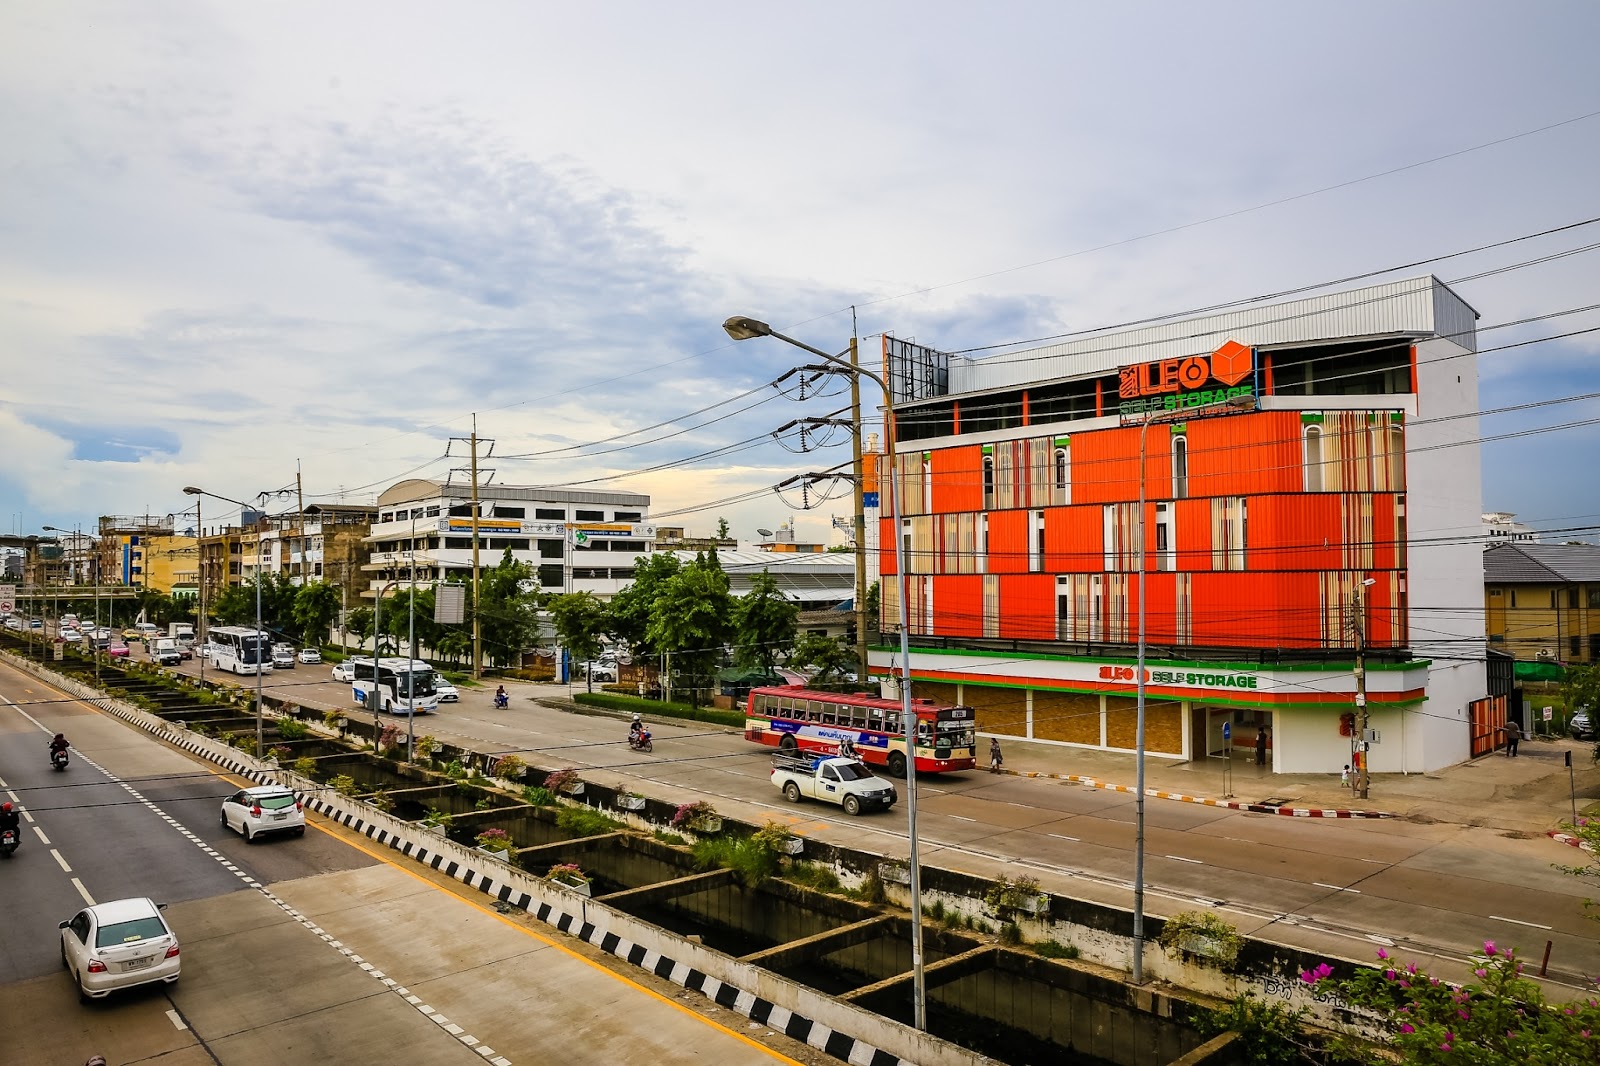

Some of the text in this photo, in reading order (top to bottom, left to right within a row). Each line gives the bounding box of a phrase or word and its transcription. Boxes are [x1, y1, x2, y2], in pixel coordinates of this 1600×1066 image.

[1140, 356, 1209, 395] LEO
[1119, 397, 1162, 415] SELF
[1152, 671, 1185, 683] SELF
[1186, 673, 1257, 688] STORAGE
